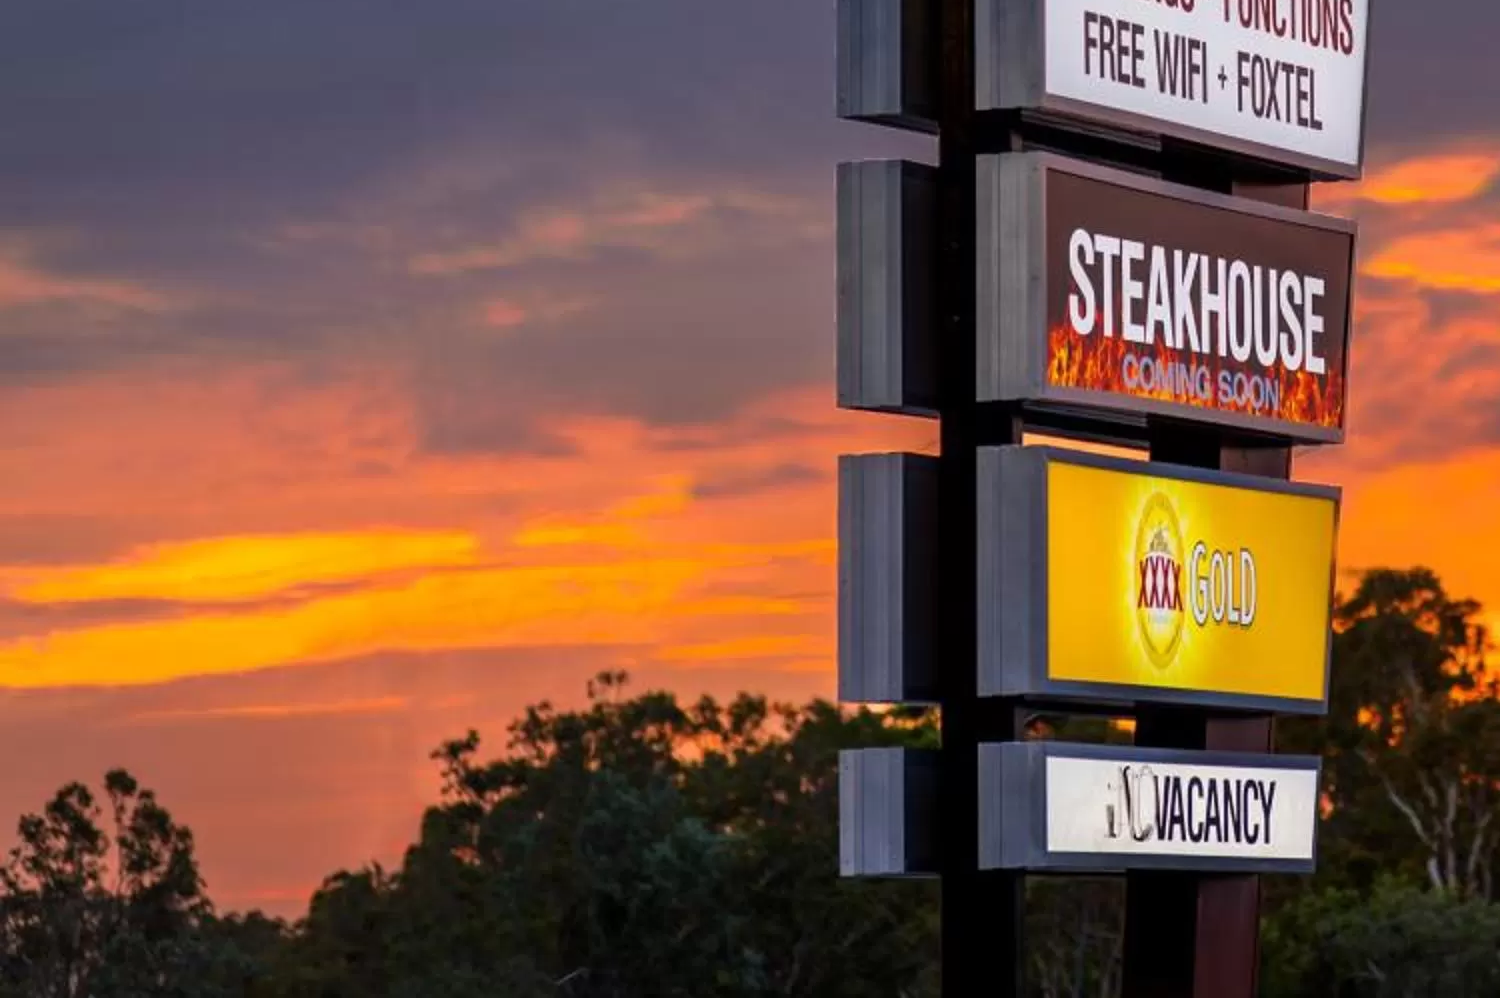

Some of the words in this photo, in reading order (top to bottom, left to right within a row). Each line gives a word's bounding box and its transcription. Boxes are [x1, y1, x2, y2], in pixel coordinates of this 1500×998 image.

[1084, 10, 1146, 88] FREE
[1154, 29, 1209, 104] WIFI
[1237, 51, 1323, 131] FOXTEL
[1069, 228, 1326, 375] STEAKHOUSE
[1122, 353, 1210, 400] COMING
[1217, 369, 1280, 411] SOON
[1137, 556, 1184, 612] XXXX
[1190, 540, 1257, 628] GOLD
[1154, 775, 1276, 844] VACANCY
